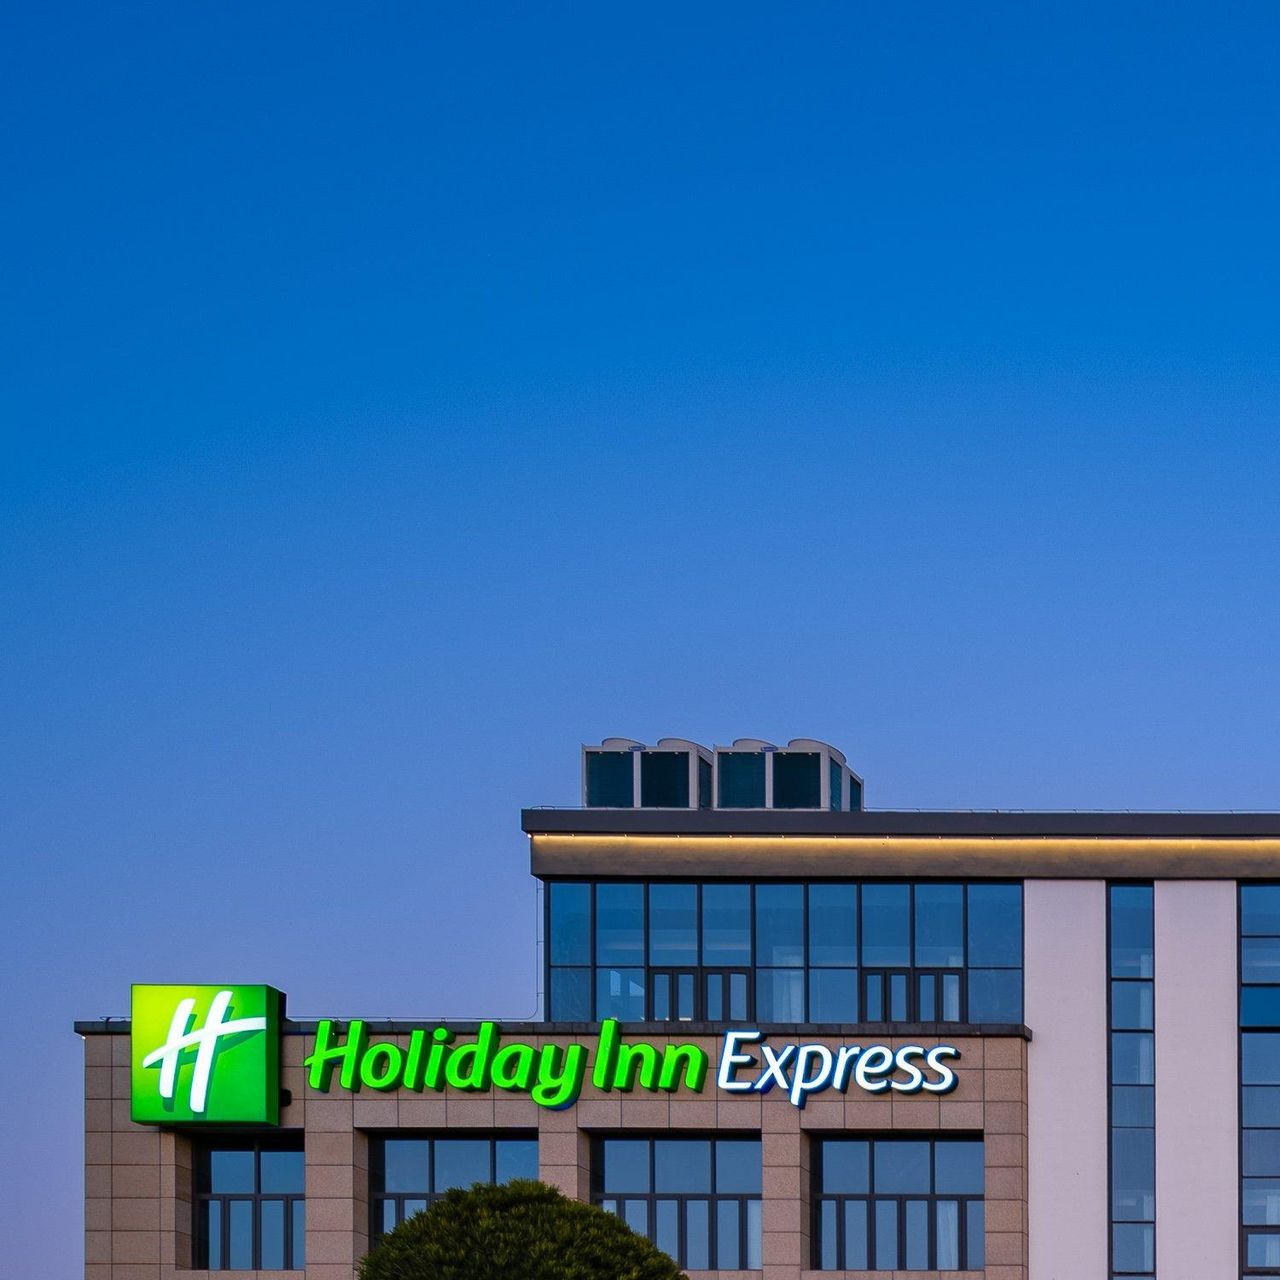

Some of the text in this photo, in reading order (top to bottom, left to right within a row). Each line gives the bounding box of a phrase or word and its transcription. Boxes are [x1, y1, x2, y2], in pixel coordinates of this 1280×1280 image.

[304, 1018, 961, 1110] Holiday Inn Express
